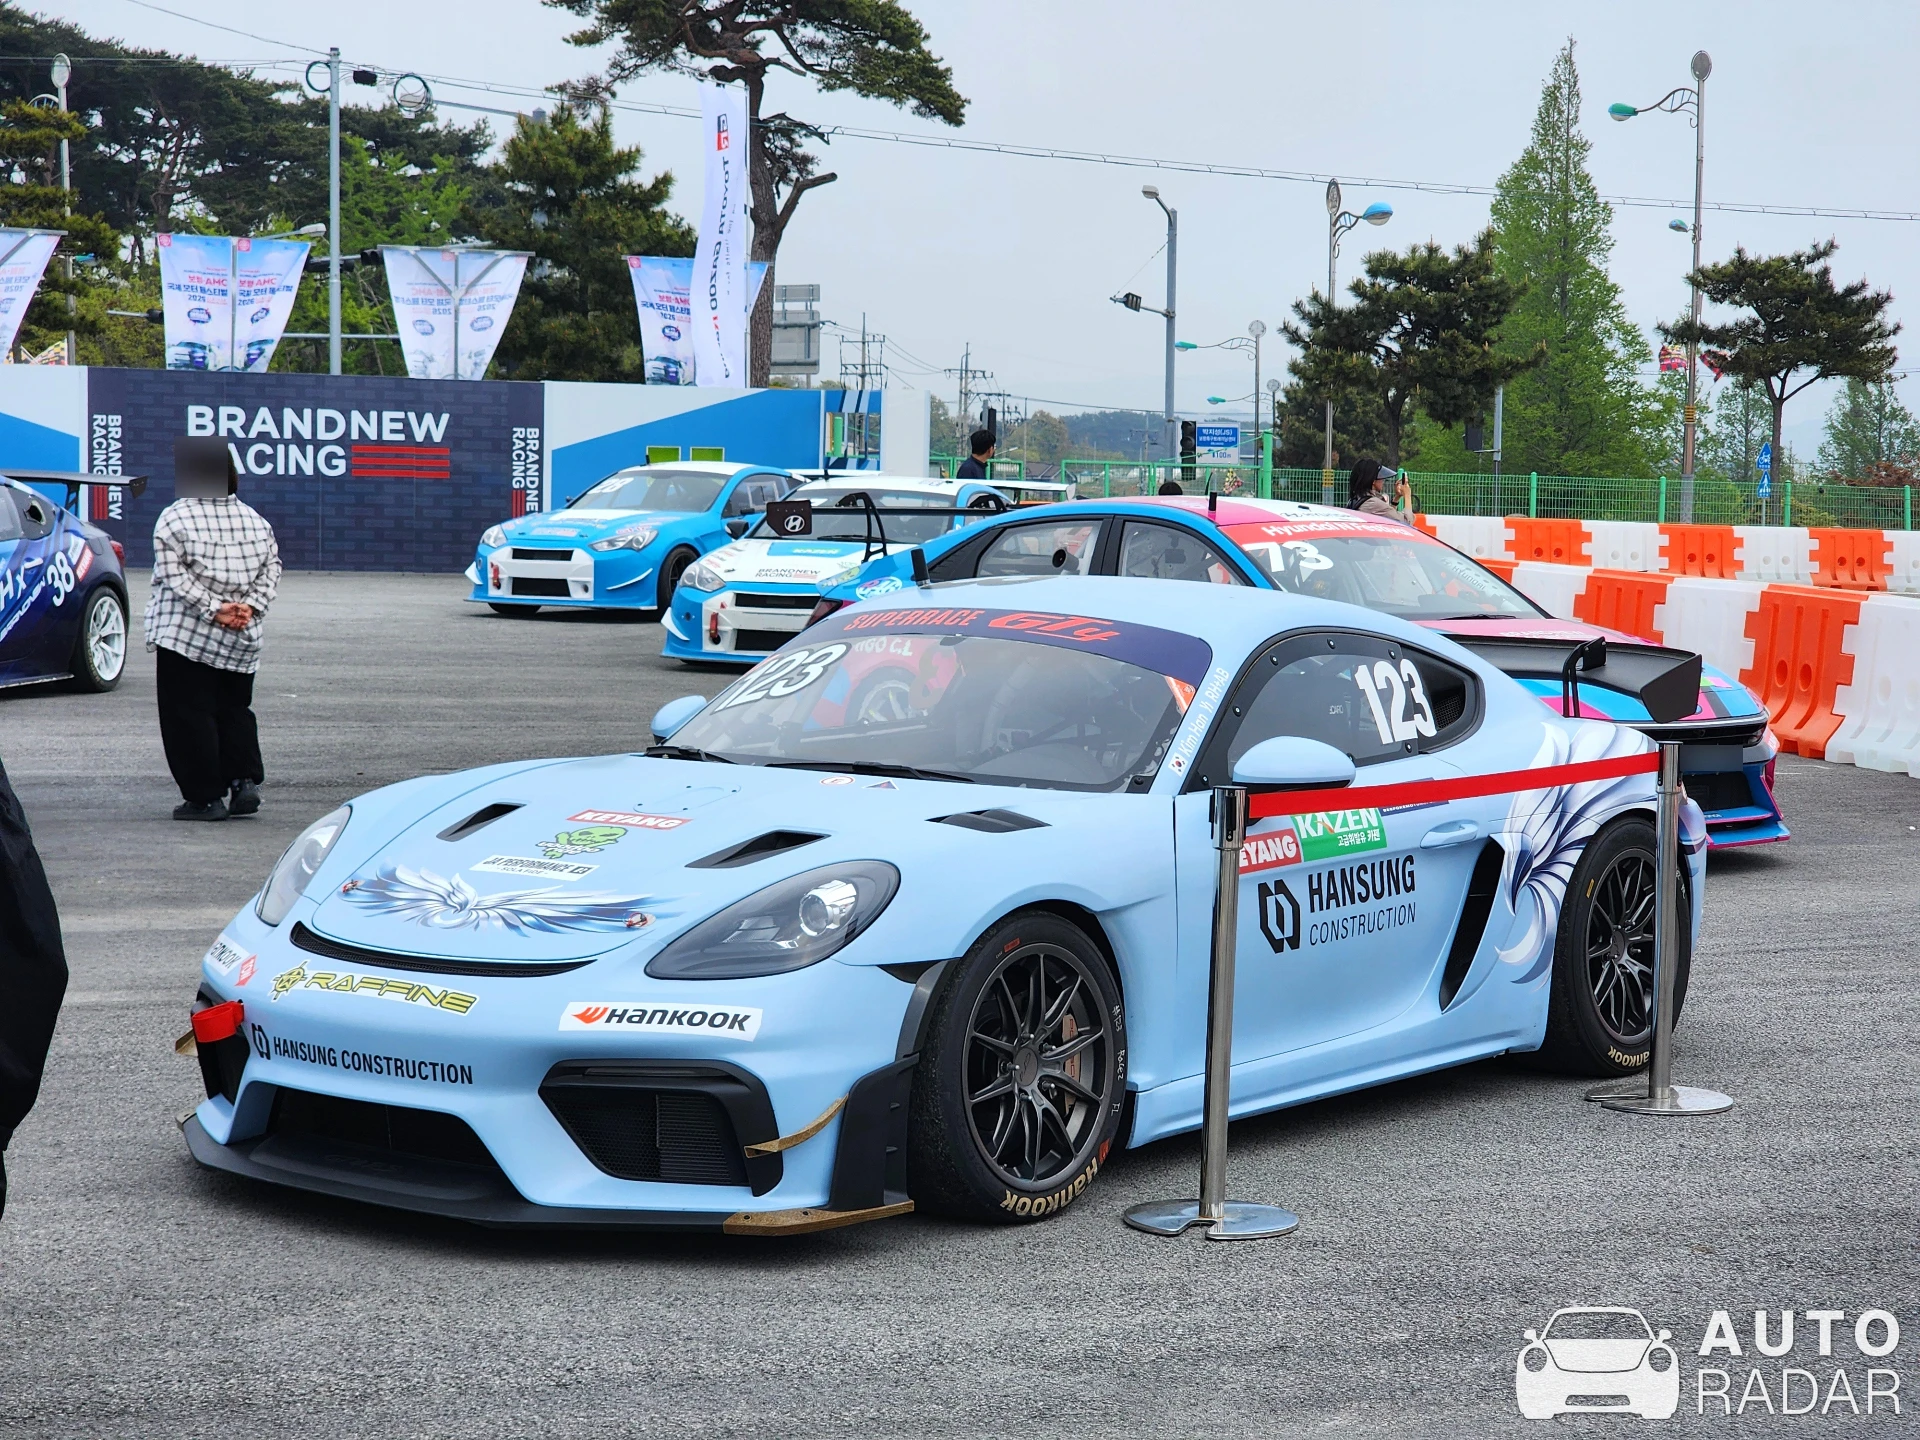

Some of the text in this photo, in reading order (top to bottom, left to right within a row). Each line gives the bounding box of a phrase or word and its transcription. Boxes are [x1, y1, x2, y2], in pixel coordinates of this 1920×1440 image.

[187, 405, 450, 443] BRANDNEW
[512, 427, 525, 489] RACING
[526, 427, 540, 514] BRANDNE
[46, 550, 75, 607] 38
[1242, 540, 1334, 573] 73
[844, 609, 986, 631] SUPERRACE
[712, 643, 849, 713] 123
[1354, 658, 1438, 745] 123
[1178, 735, 1197, 757] Kim
[1188, 713, 1209, 738] Han
[576, 811, 683, 829] KEYANG
[1295, 806, 1380, 840] KAZEN
[1239, 834, 1297, 868] EYANG
[1307, 854, 1416, 914] HANSUNG
[1309, 901, 1416, 946] CONSTRUCTION
[305, 972, 478, 1015] RAFFINE
[273, 1036, 473, 1085] HANSUNG CONSTRUCTION
